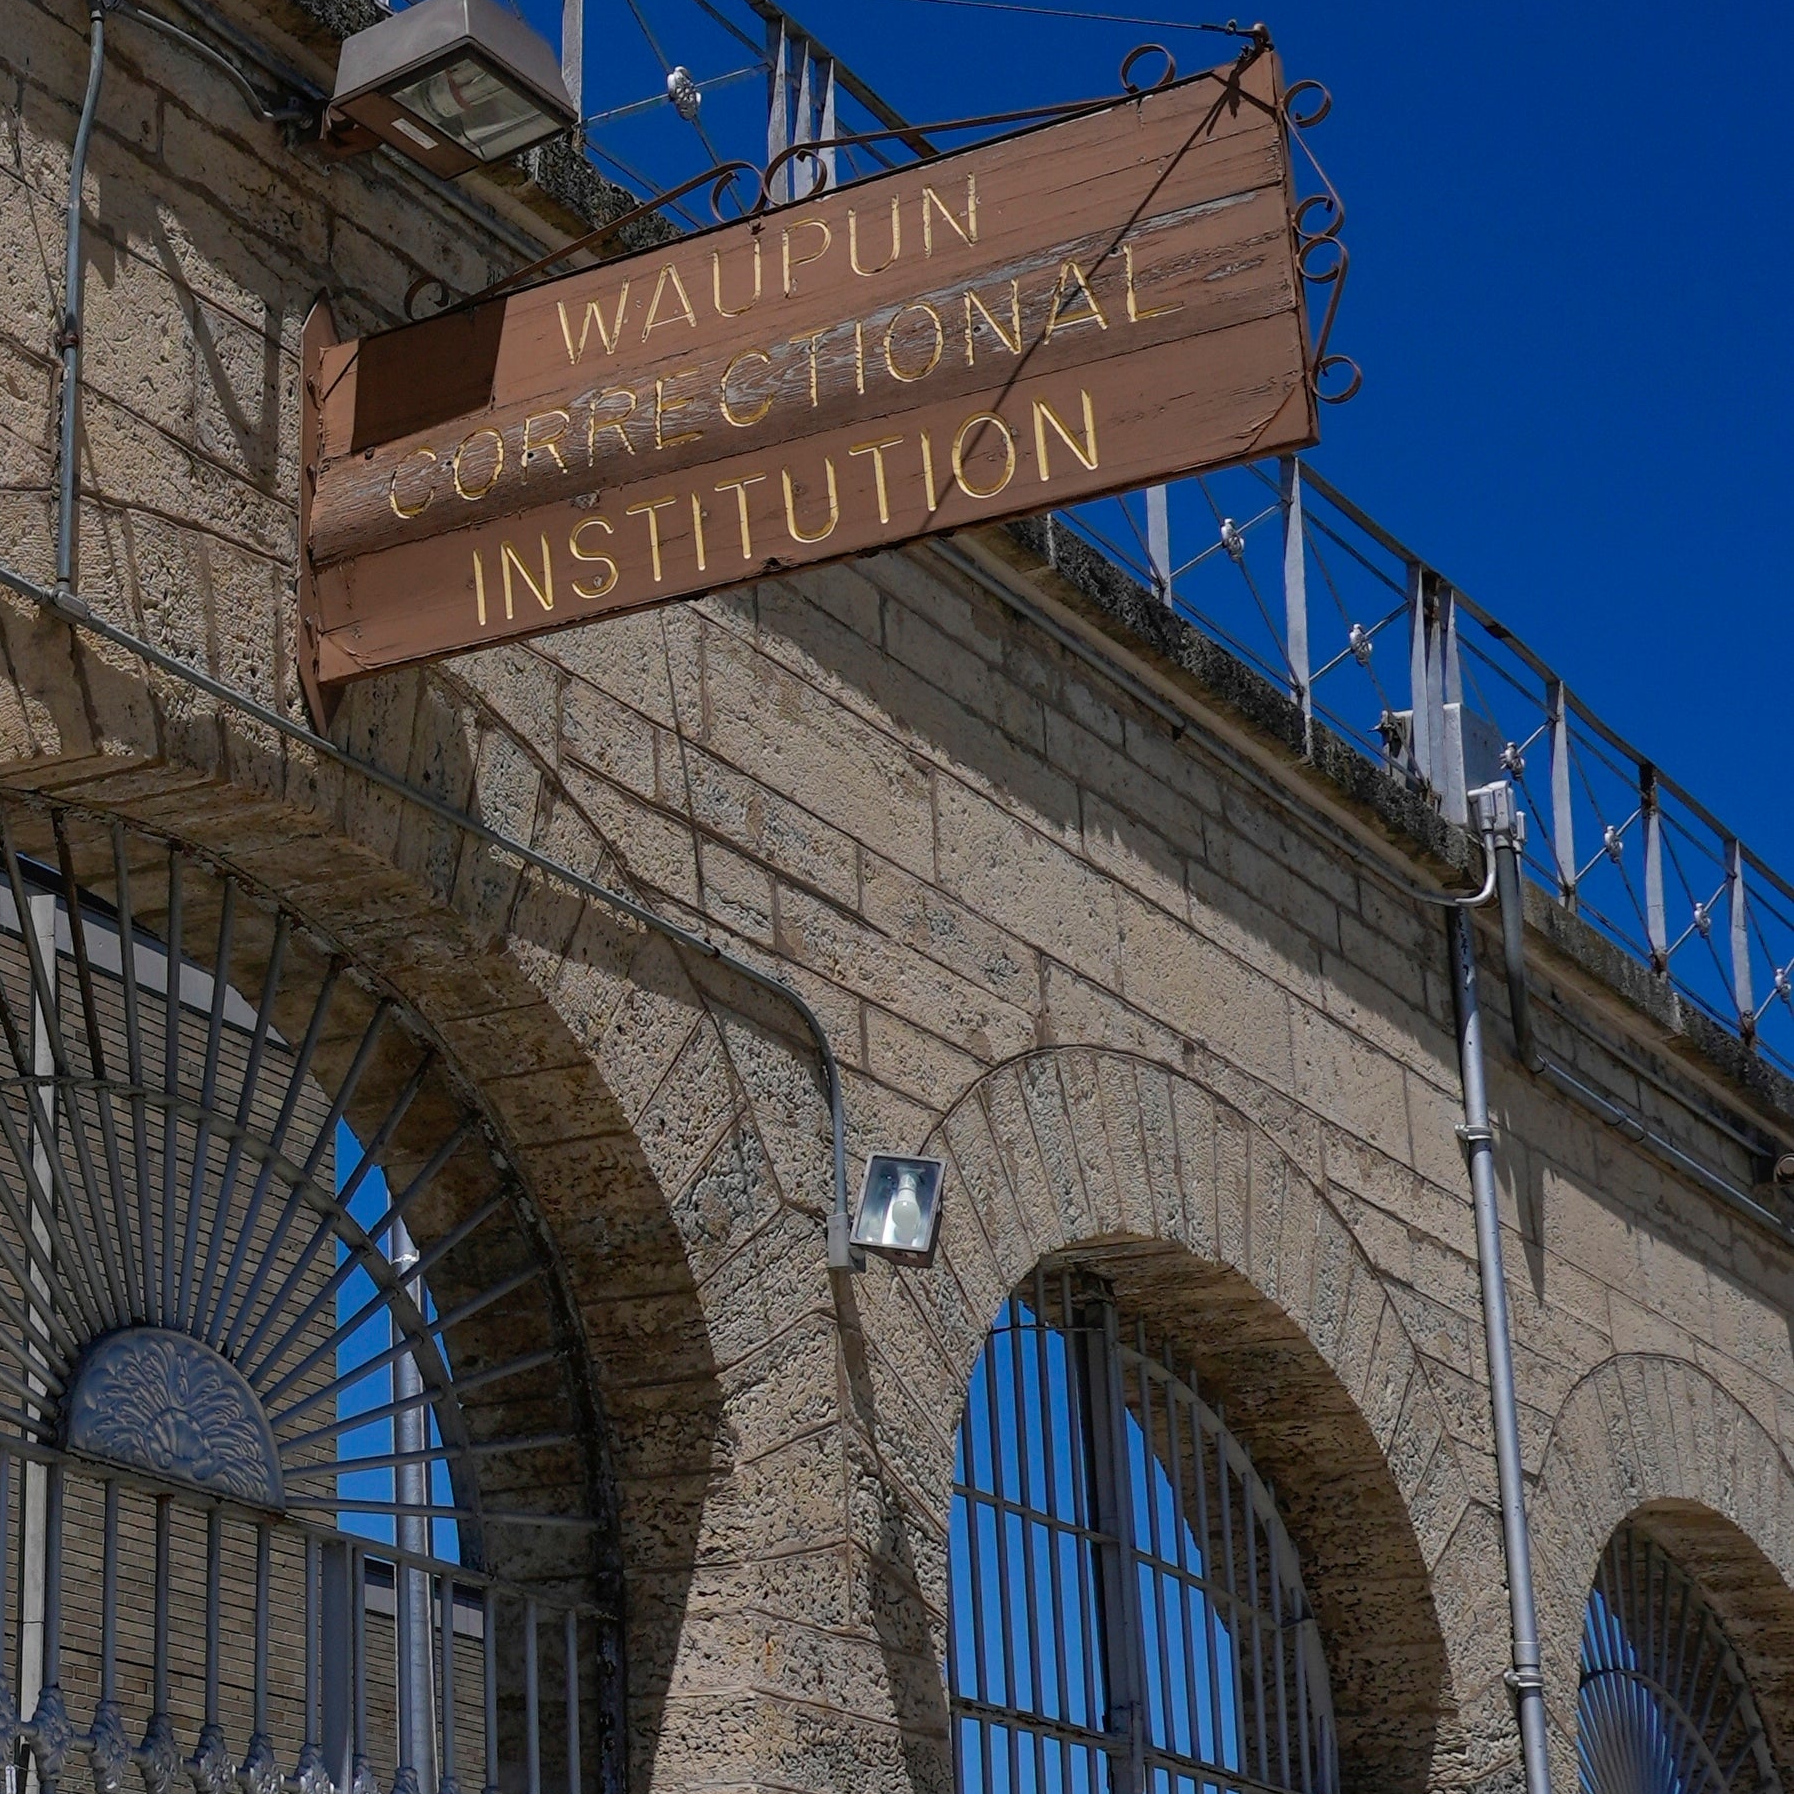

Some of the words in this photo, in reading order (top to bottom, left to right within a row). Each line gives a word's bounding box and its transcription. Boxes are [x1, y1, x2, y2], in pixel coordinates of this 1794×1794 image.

[388, 243, 1185, 521] CORRECTIONAL
[555, 171, 980, 366] WAUPUN
[470, 387, 1102, 627] INSTITUTION
